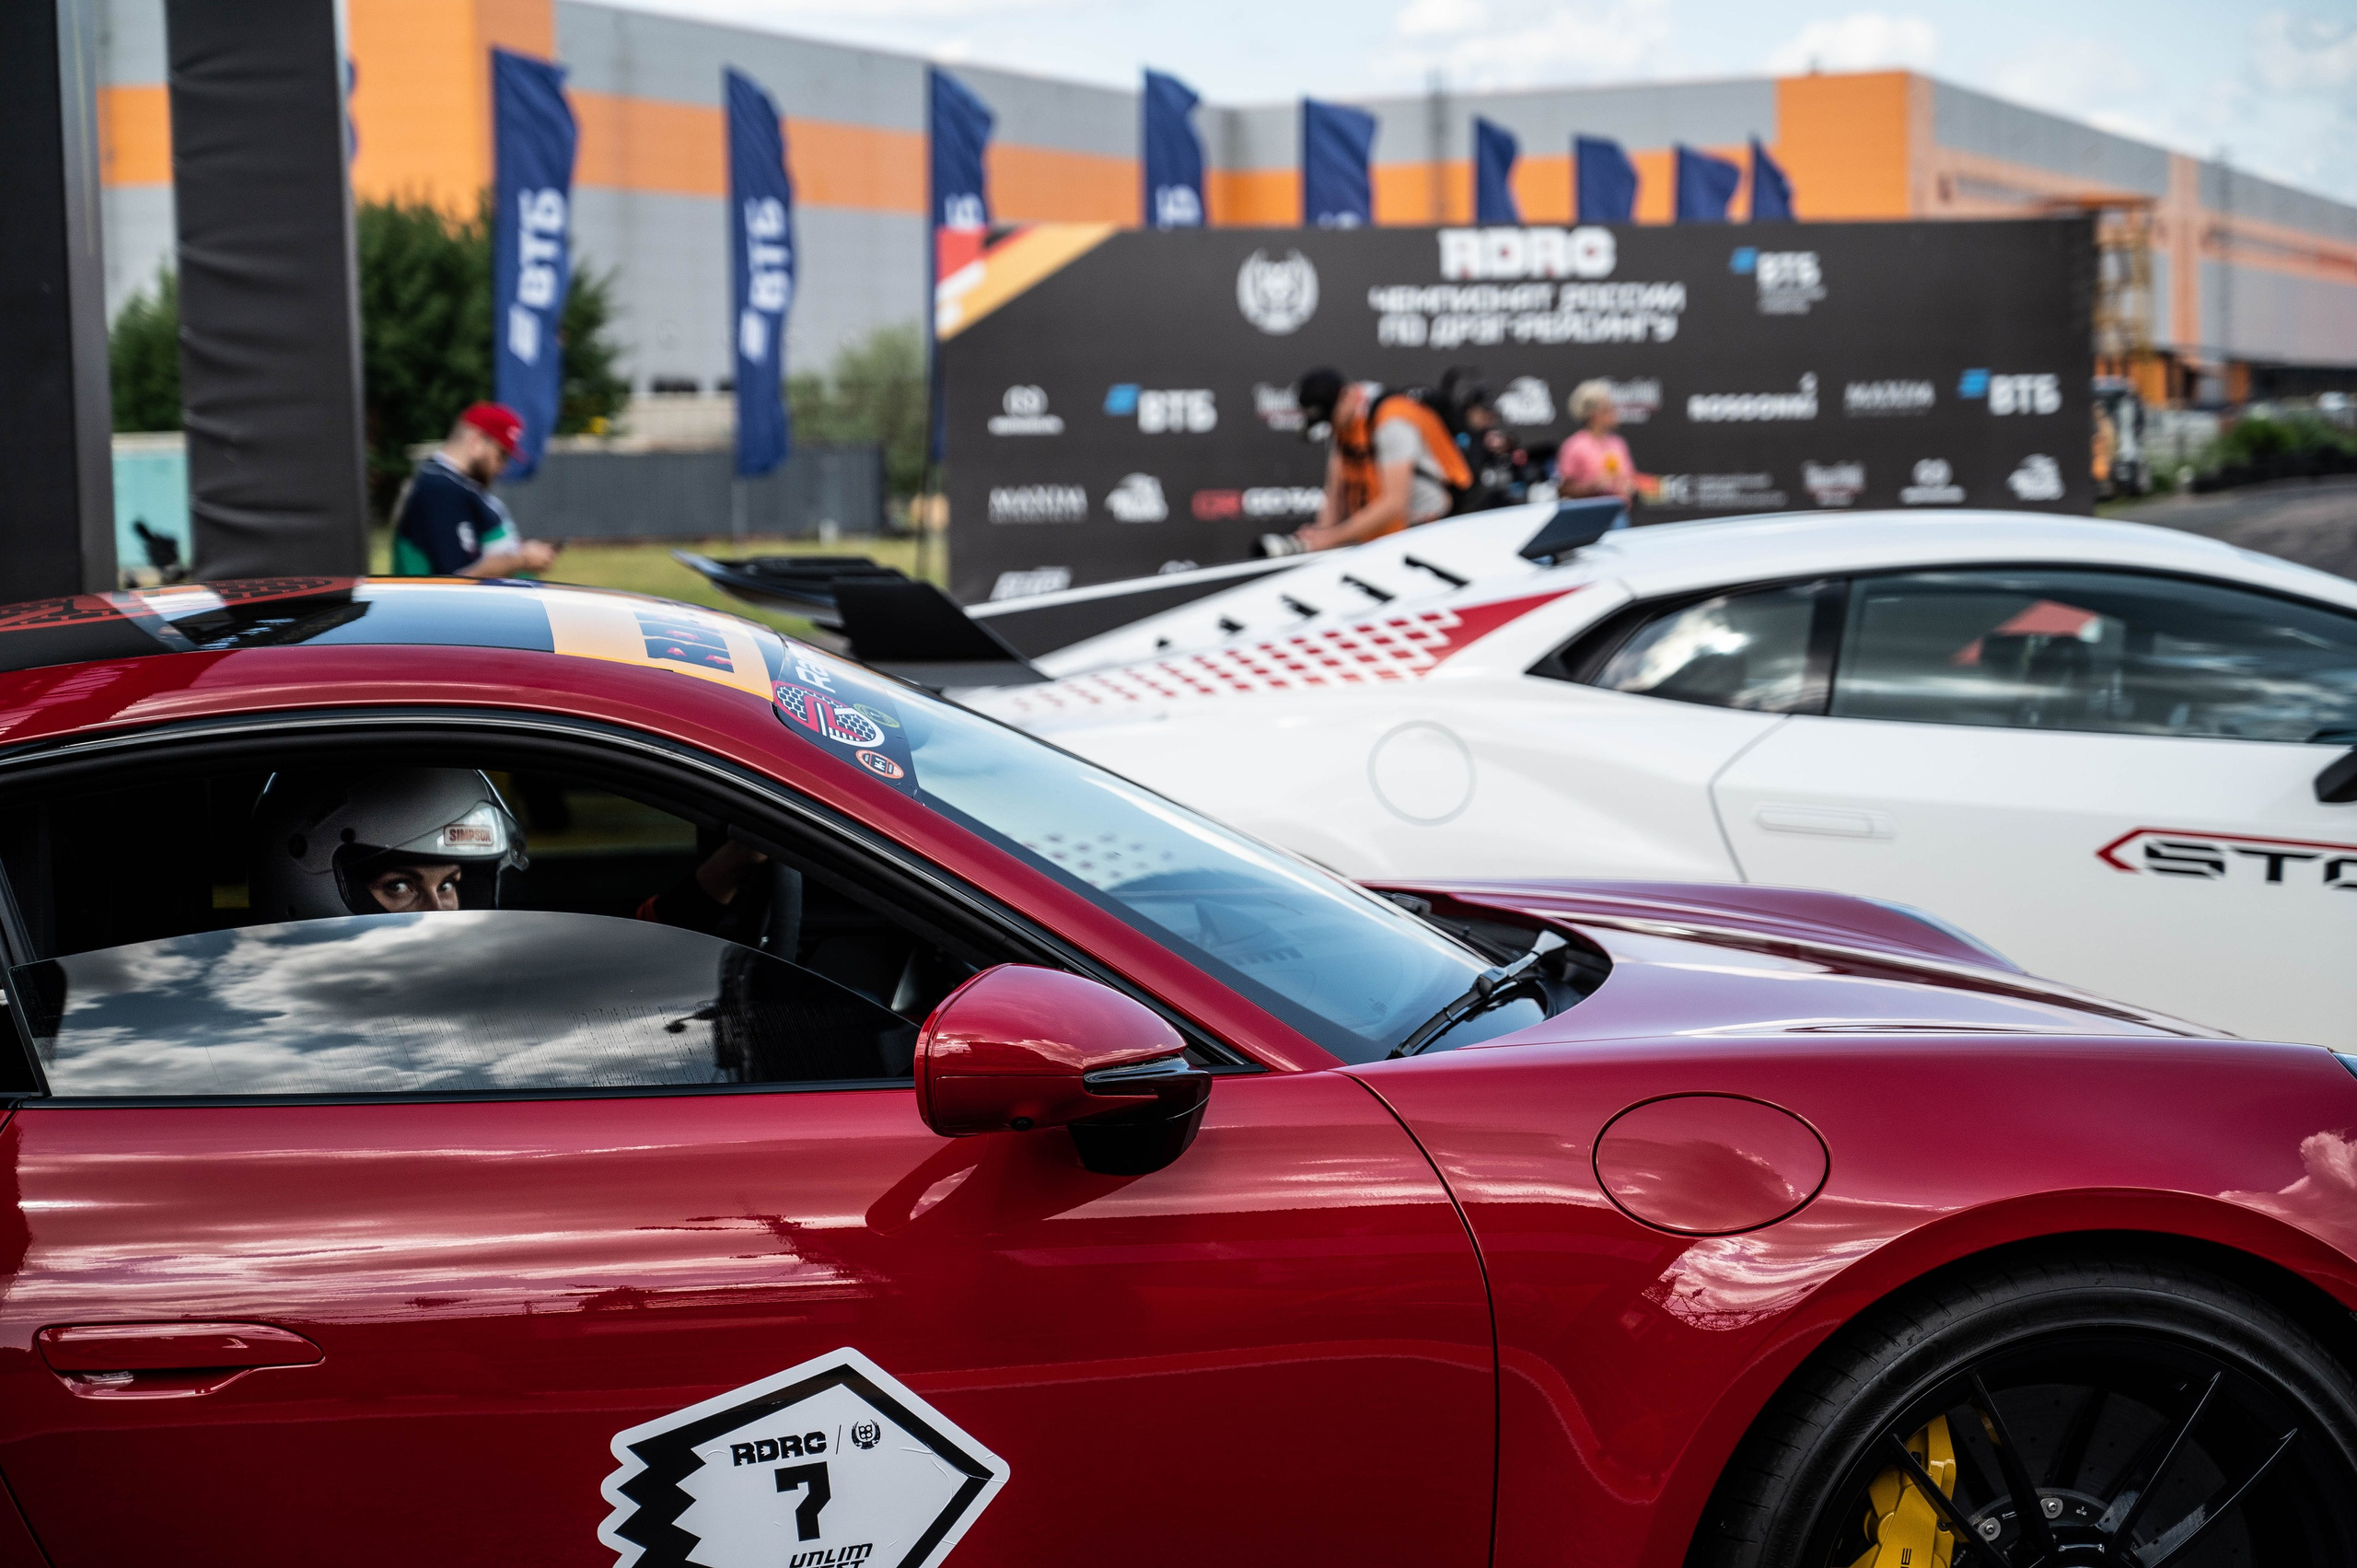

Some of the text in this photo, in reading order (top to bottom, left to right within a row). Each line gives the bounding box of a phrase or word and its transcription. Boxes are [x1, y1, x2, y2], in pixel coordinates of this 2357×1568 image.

[518, 187, 565, 308] ВТБ
[743, 196, 790, 311] ВТБ
[1756, 250, 1821, 288] ВТБ
[1138, 389, 1217, 433] ВТБ
[1990, 374, 2061, 414] ВТБ
[449, 829, 491, 842] SIMPSON
[730, 1431, 827, 1467] RDRC
[774, 1461, 831, 1542] 7
[789, 1543, 873, 1568] UNLIM
